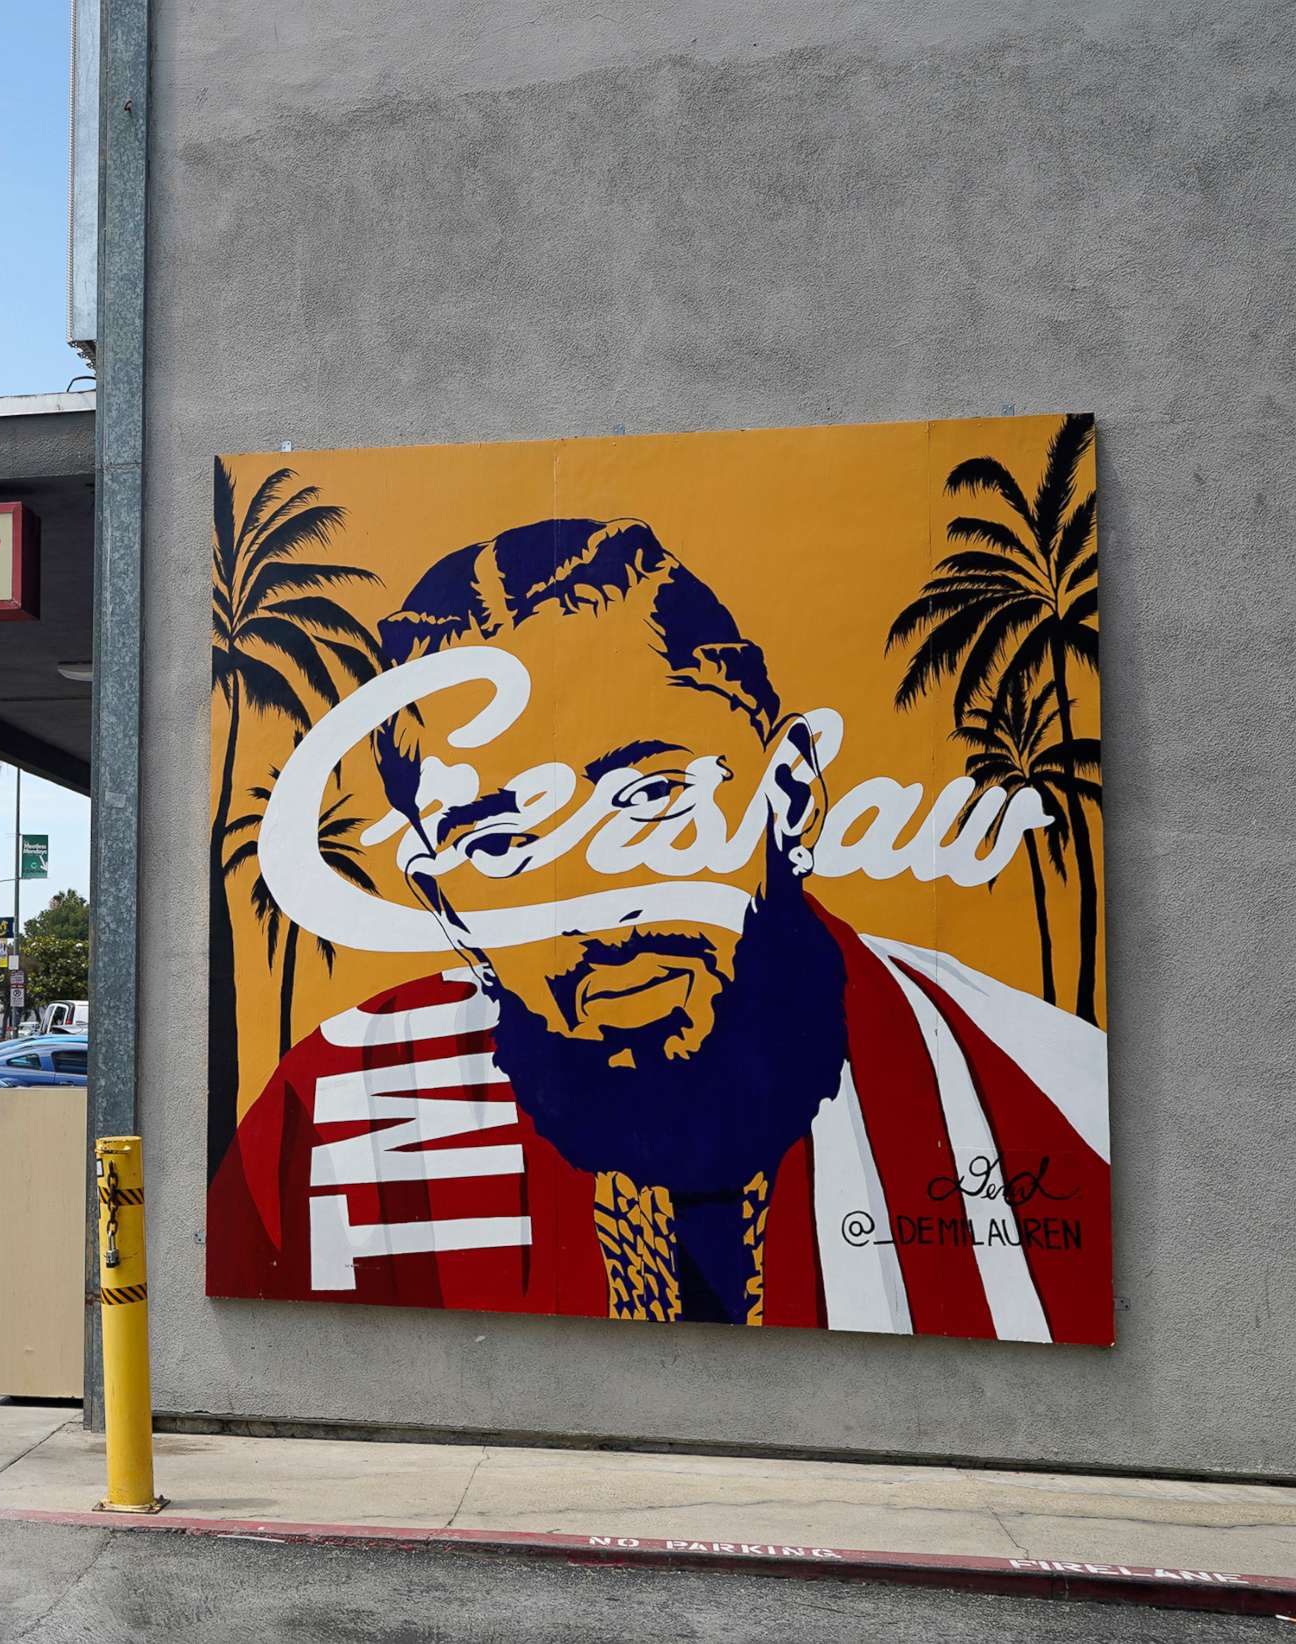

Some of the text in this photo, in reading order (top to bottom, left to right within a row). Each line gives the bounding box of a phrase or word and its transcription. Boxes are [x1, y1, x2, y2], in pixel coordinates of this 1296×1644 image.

[841, 1210, 1082, 1250] @_DEMILAUREN
[589, 1536, 842, 1559] NO PARKING
